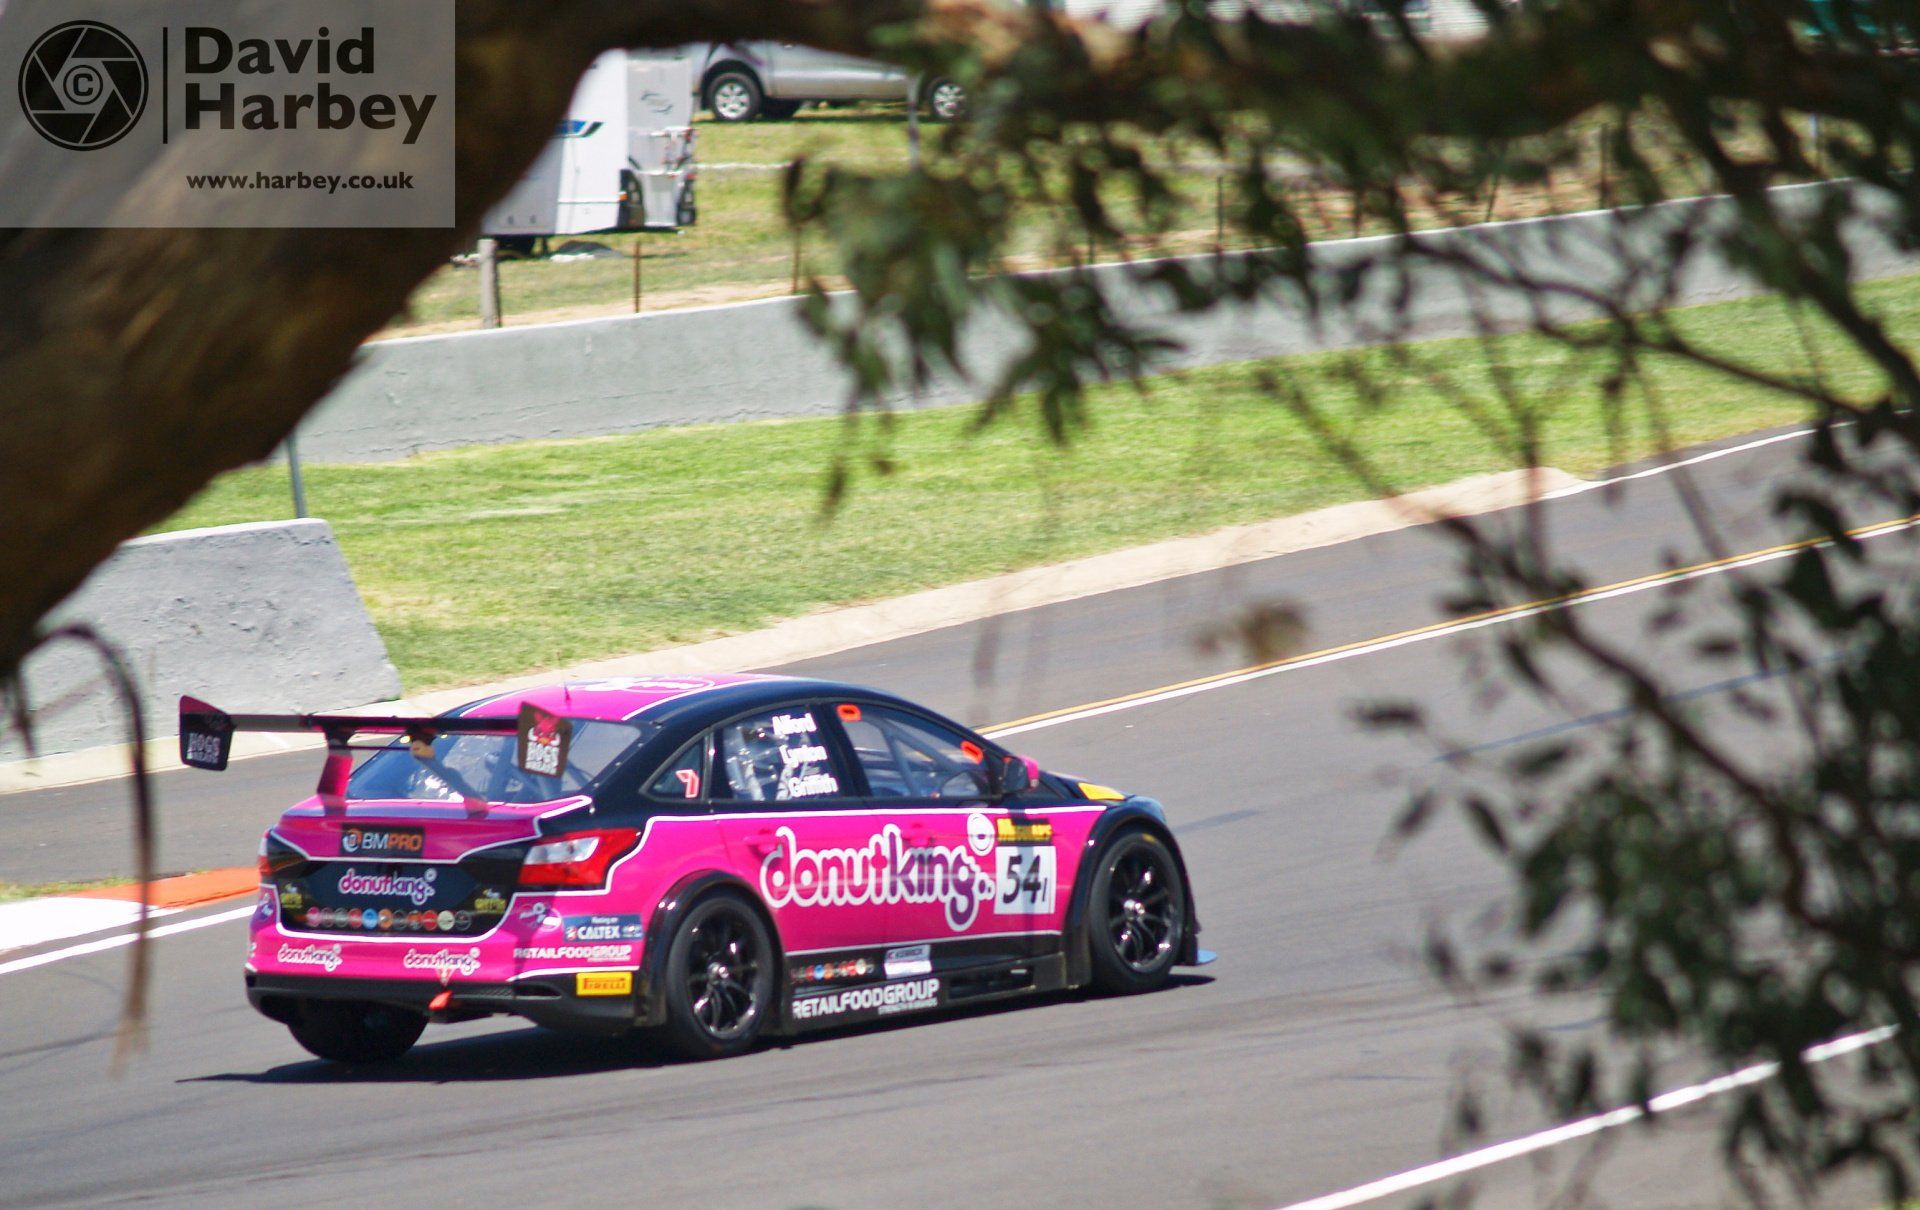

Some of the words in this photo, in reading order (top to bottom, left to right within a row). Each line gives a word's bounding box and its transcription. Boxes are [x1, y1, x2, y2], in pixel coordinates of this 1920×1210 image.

[362, 832, 423, 851] BMPRO
[760, 824, 985, 931] donutking
[577, 926, 620, 940] CALTEX
[583, 977, 626, 990] PIRELLI
